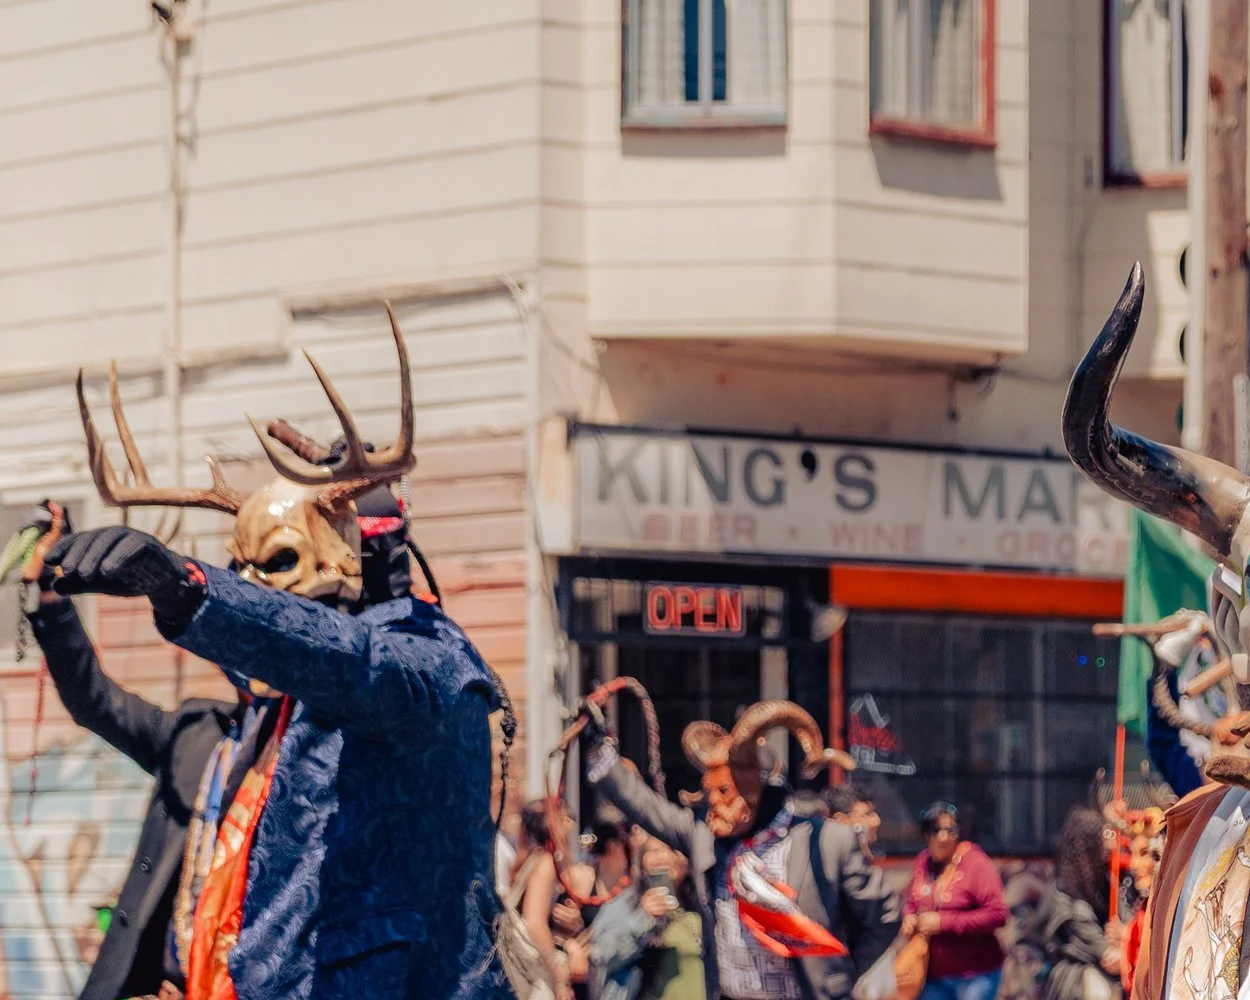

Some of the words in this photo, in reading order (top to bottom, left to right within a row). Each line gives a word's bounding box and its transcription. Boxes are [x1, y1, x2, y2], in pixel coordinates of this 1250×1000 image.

[595, 438, 878, 514] KING'S
[941, 460, 1131, 533] MAR
[641, 511, 759, 545] BEER
[829, 521, 924, 553] WINE
[647, 585, 743, 632] OPEN
